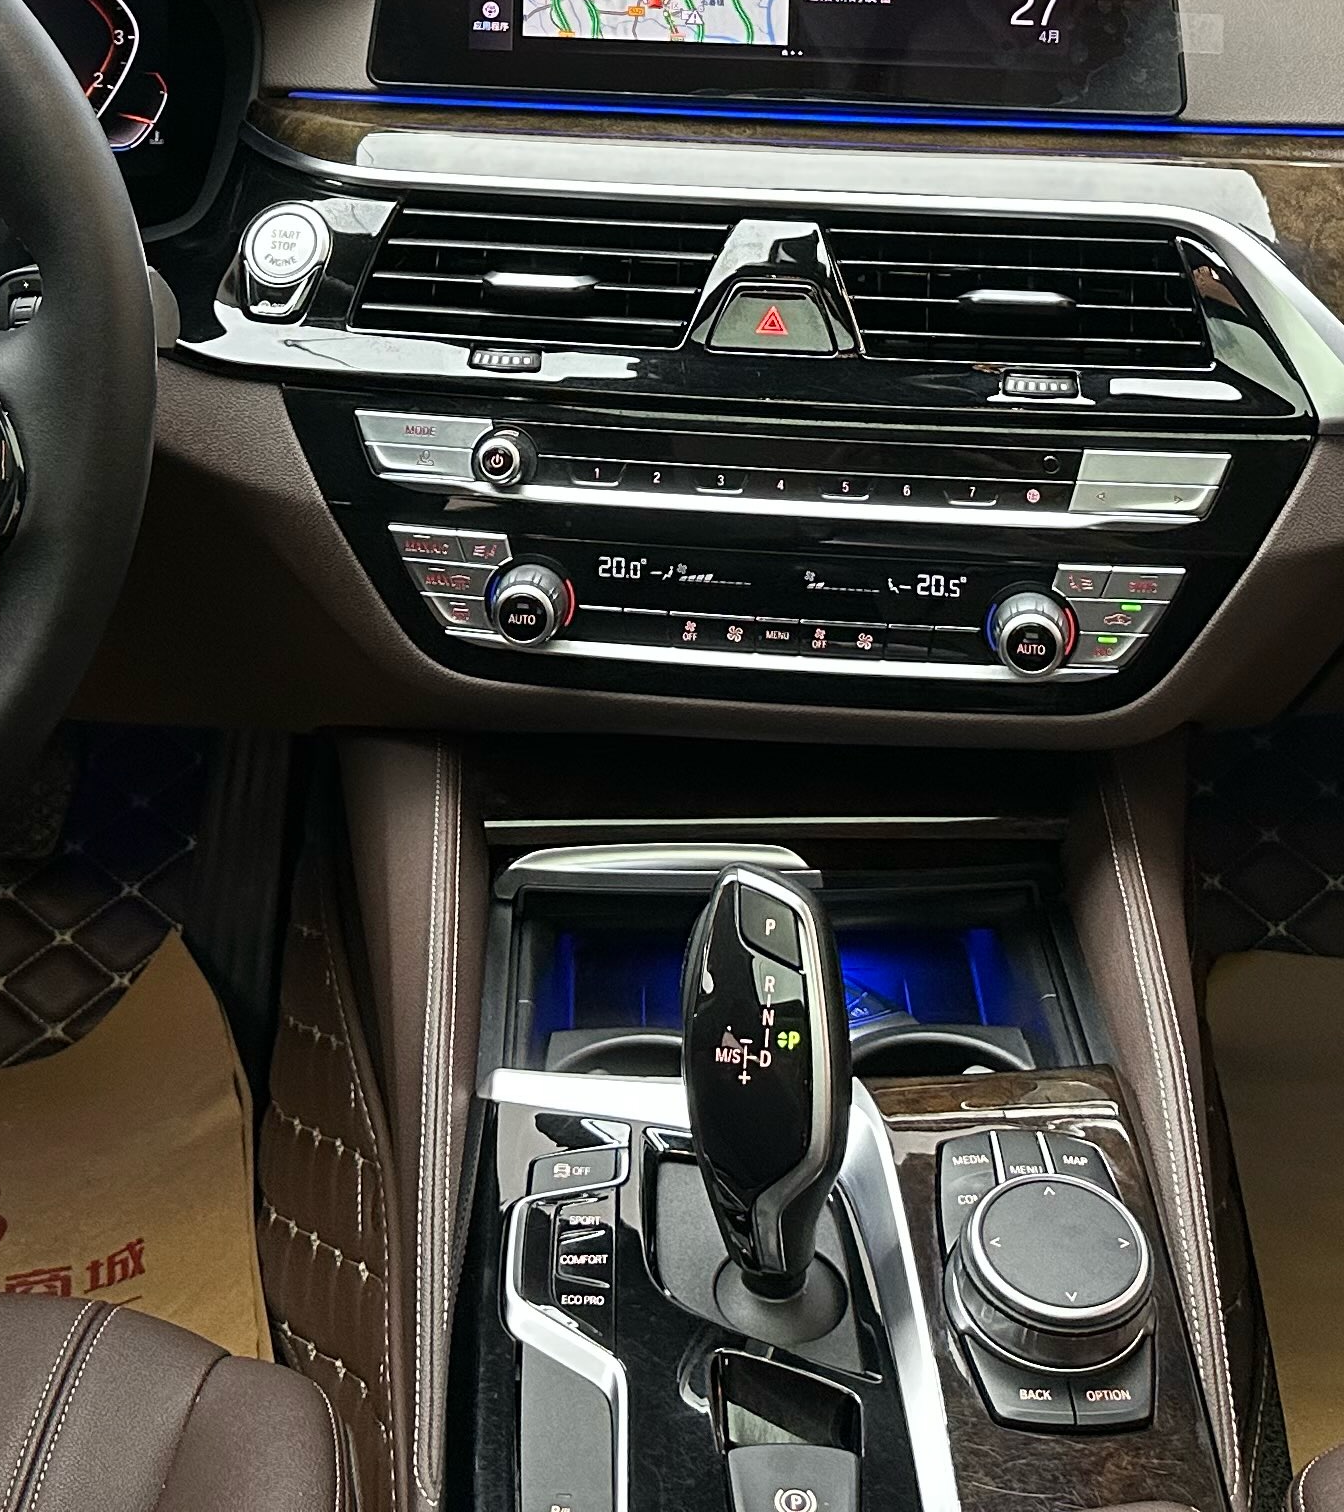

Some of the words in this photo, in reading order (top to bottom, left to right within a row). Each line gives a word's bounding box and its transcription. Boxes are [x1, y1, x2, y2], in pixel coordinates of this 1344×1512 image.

[113, 29, 124, 45] 3
[1038, 29, 1060, 44] 4月
[93, 72, 104, 88] 2
[270, 229, 301, 240] START
[270, 240, 297, 251] STOP
[405, 425, 437, 436] MODE
[652, 472, 661, 484] 2
[716, 474, 725, 487] 3
[776, 479, 785, 491] 4
[841, 480, 850, 493] 5
[902, 485, 911, 497] 6
[969, 486, 977, 498] 7
[508, 614, 536, 625] AUTO
[682, 631, 697, 641] OFF
[766, 630, 789, 640] MENU
[812, 639, 827, 649] OFF
[1016, 643, 1046, 655] AUTO
[765, 918, 776, 936] P
[764, 975, 775, 993] R
[762, 1008, 775, 1027] N
[787, 1030, 801, 1050] P
[715, 1047, 742, 1064] M/S
[759, 1049, 772, 1068] D
[952, 1154, 990, 1166] MEDIA
[1062, 1154, 1089, 1166] MAP
[572, 1165, 592, 1176] OFF
[569, 1214, 602, 1226] SPORT
[559, 1254, 609, 1266] COMFORT
[560, 1294, 582, 1306] ECO
[583, 1294, 605, 1306] PRO
[1019, 1388, 1053, 1401] BACK
[1085, 1389, 1132, 1402] OPTION
